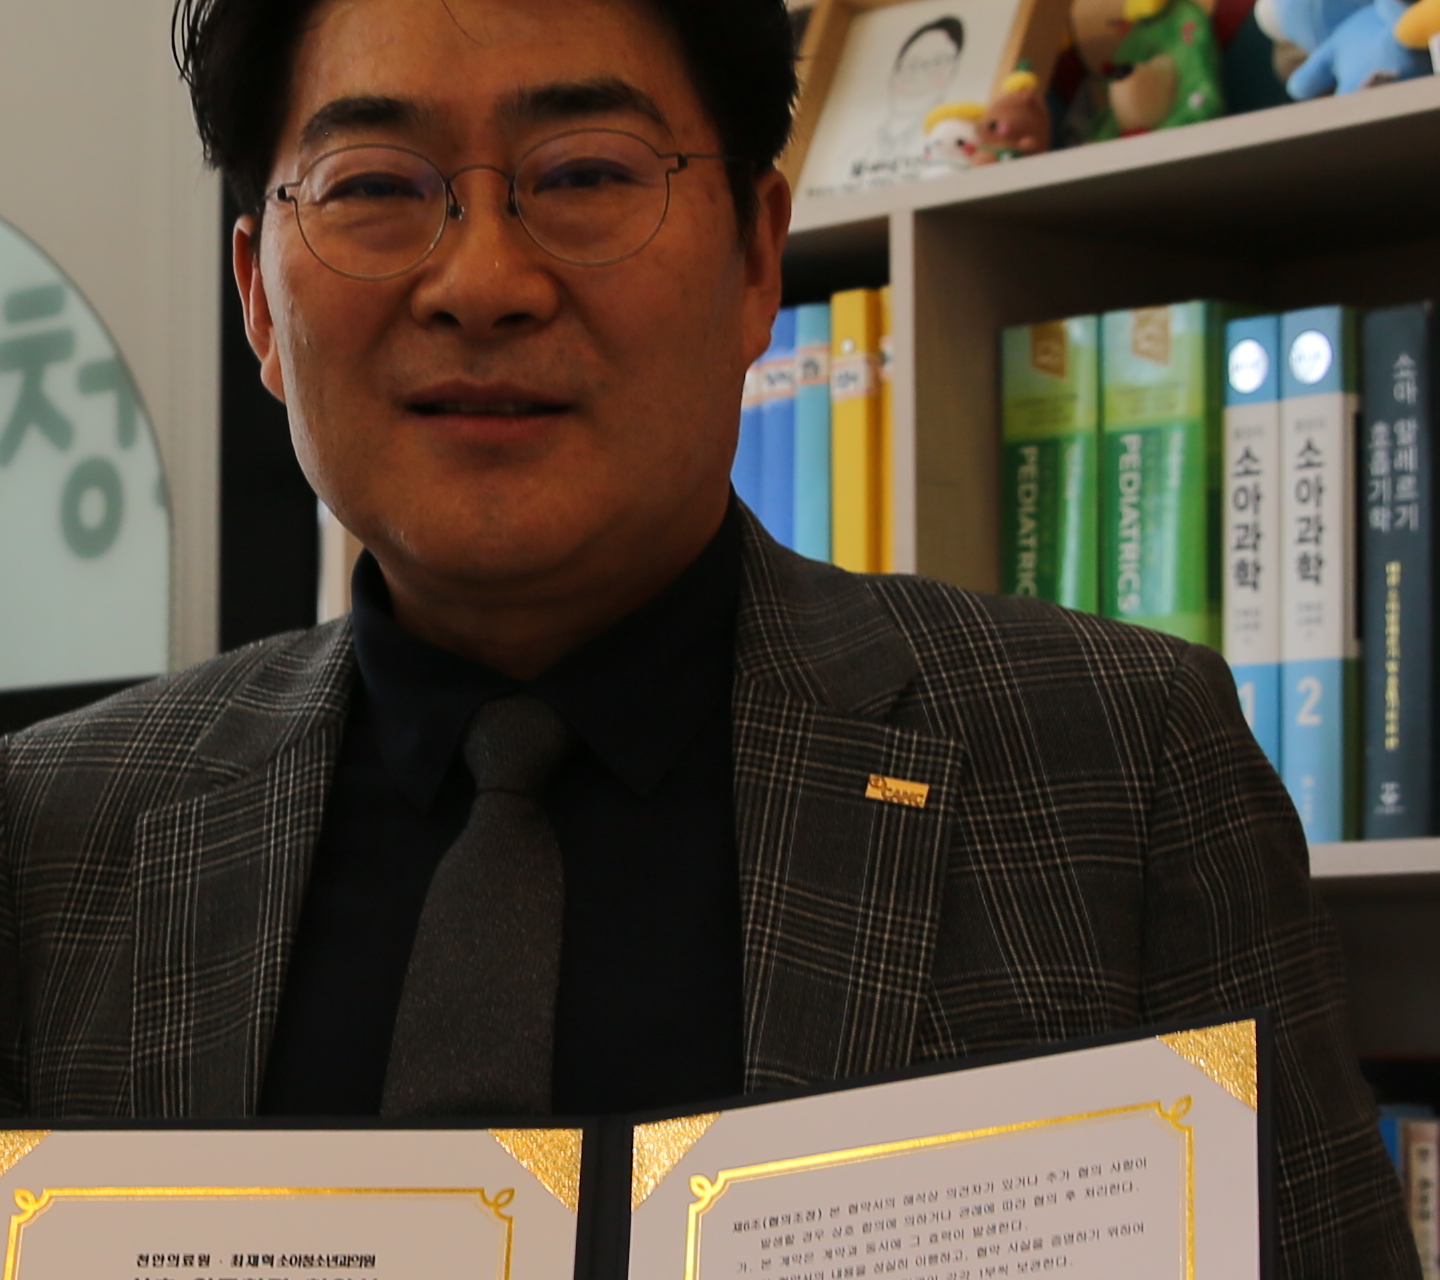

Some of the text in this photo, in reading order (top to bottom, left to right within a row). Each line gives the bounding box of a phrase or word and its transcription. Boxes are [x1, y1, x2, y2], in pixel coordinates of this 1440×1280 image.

[1295, 438, 1323, 584] 소아과학
[1393, 353, 1419, 531] 소아 알레르기
[1016, 447, 1038, 596] PEDIATRIC
[1117, 434, 1141, 613] PEDIATRICS
[1233, 447, 1263, 591] 소아과학
[1297, 677, 1323, 726] 2
[135, 1252, 376, 1269] 천안의료원 최재혁소아청소년과의원
